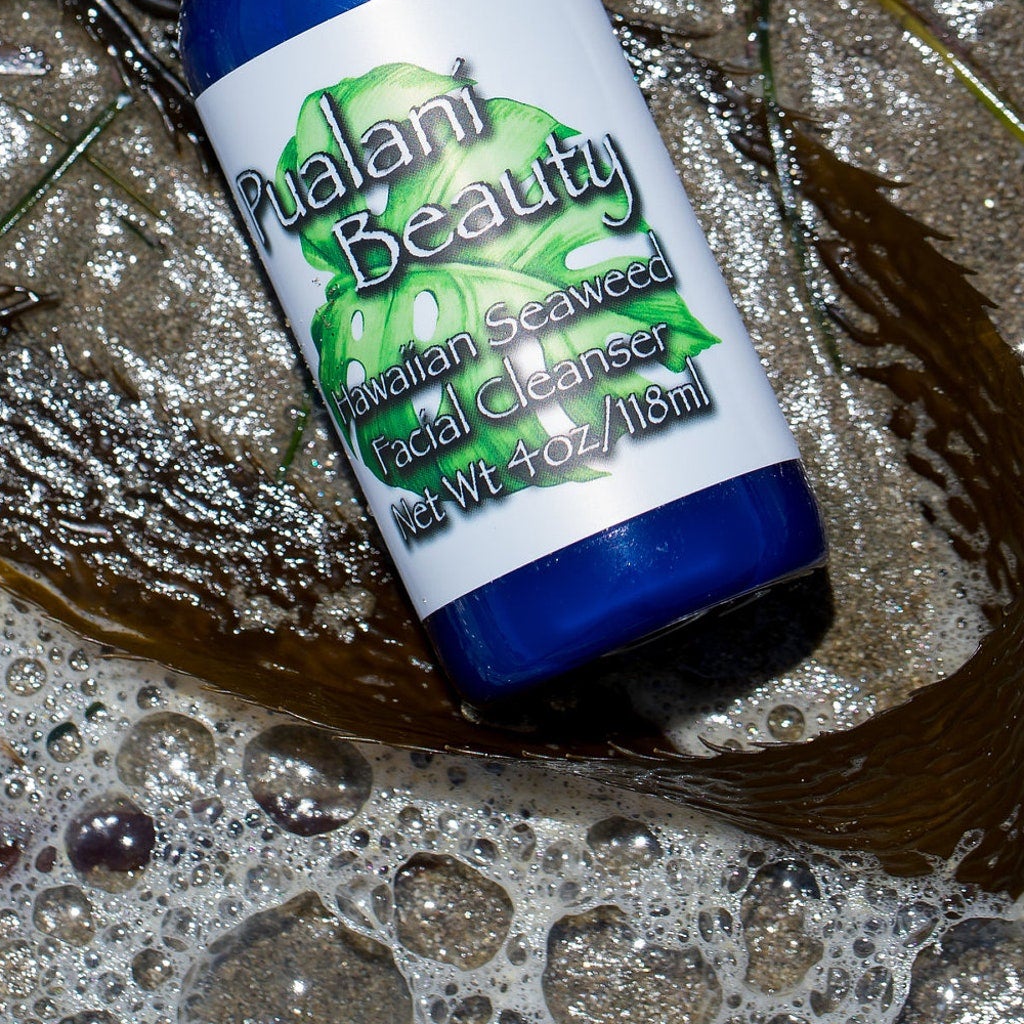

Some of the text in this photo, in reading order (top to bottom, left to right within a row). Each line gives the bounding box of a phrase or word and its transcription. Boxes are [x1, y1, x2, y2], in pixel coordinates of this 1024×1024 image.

[236, 58, 485, 244] Pualani
[332, 133, 634, 292] Beauty
[331, 230, 675, 425] Hawaiian Seaweed
[372, 322, 668, 476] Facial Cleanser
[391, 488, 446, 541] Net
[442, 458, 504, 510] Wt
